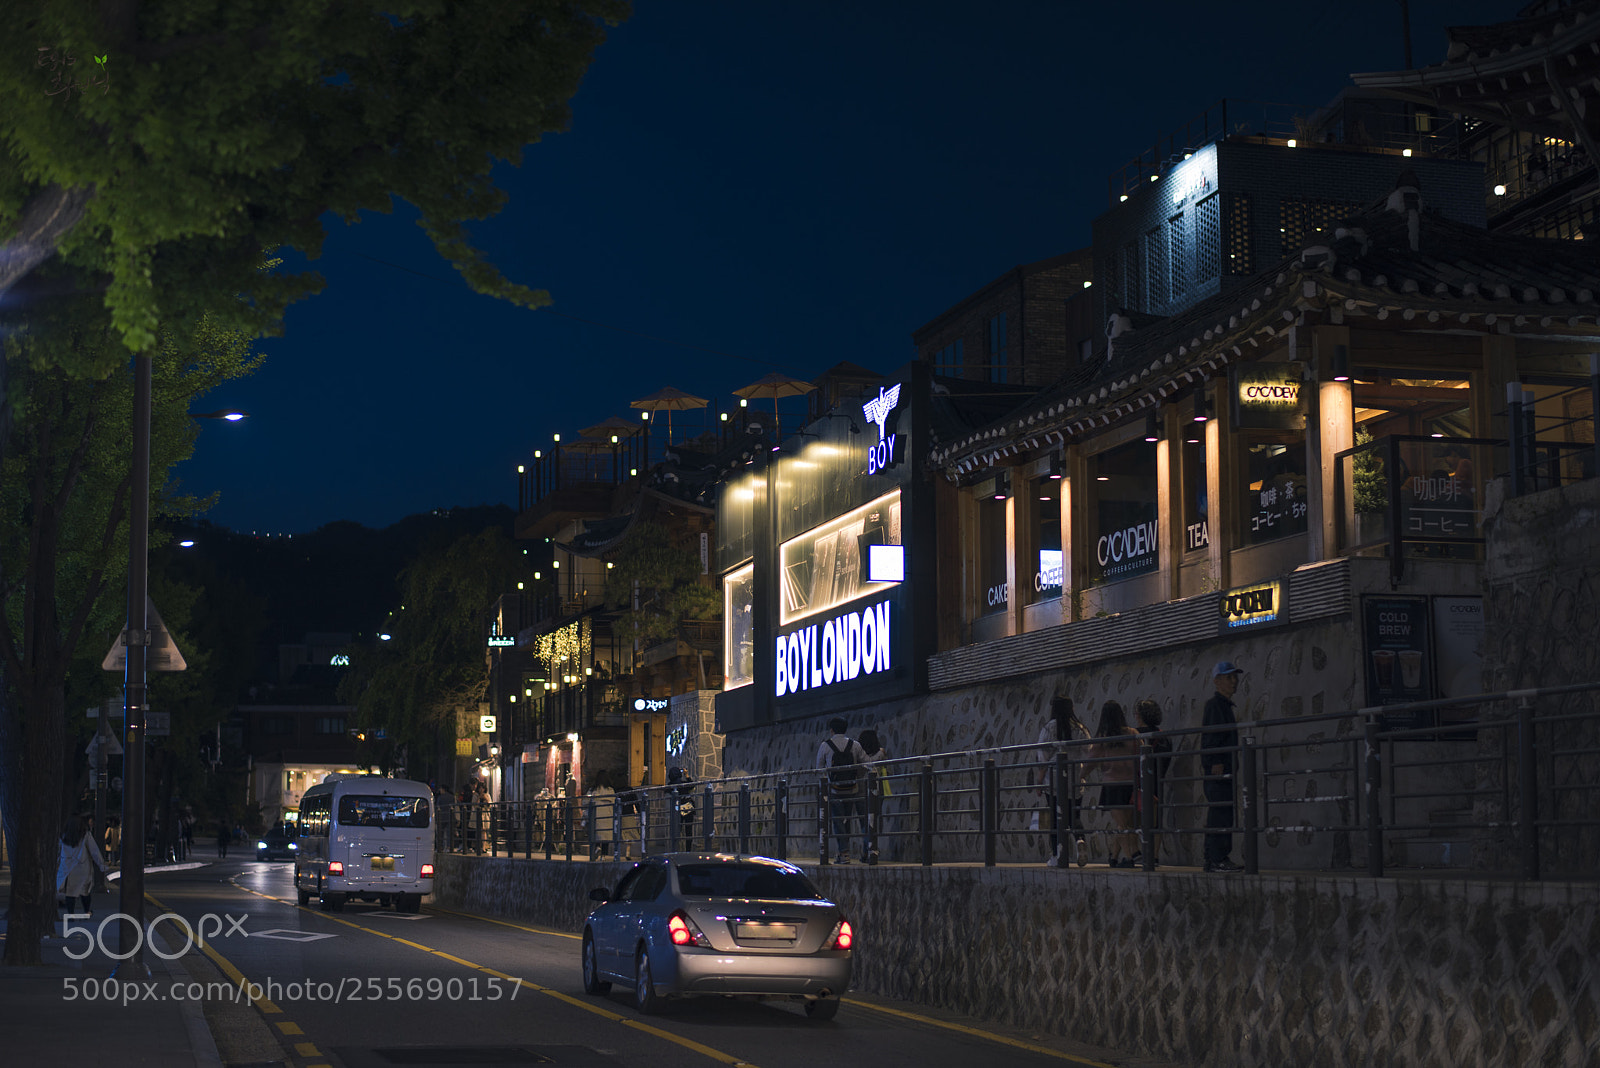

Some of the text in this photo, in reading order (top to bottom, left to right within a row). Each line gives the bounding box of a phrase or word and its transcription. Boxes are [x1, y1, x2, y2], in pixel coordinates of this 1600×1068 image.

[1247, 386, 1299, 399] CACADEW
[868, 433, 896, 475] BOY
[1097, 519, 1158, 566] CACADEW
[1187, 521, 1209, 548] TEA
[988, 583, 1008, 606] CAKE
[1379, 612, 1408, 622] COLD
[1379, 625, 1411, 635] BREW
